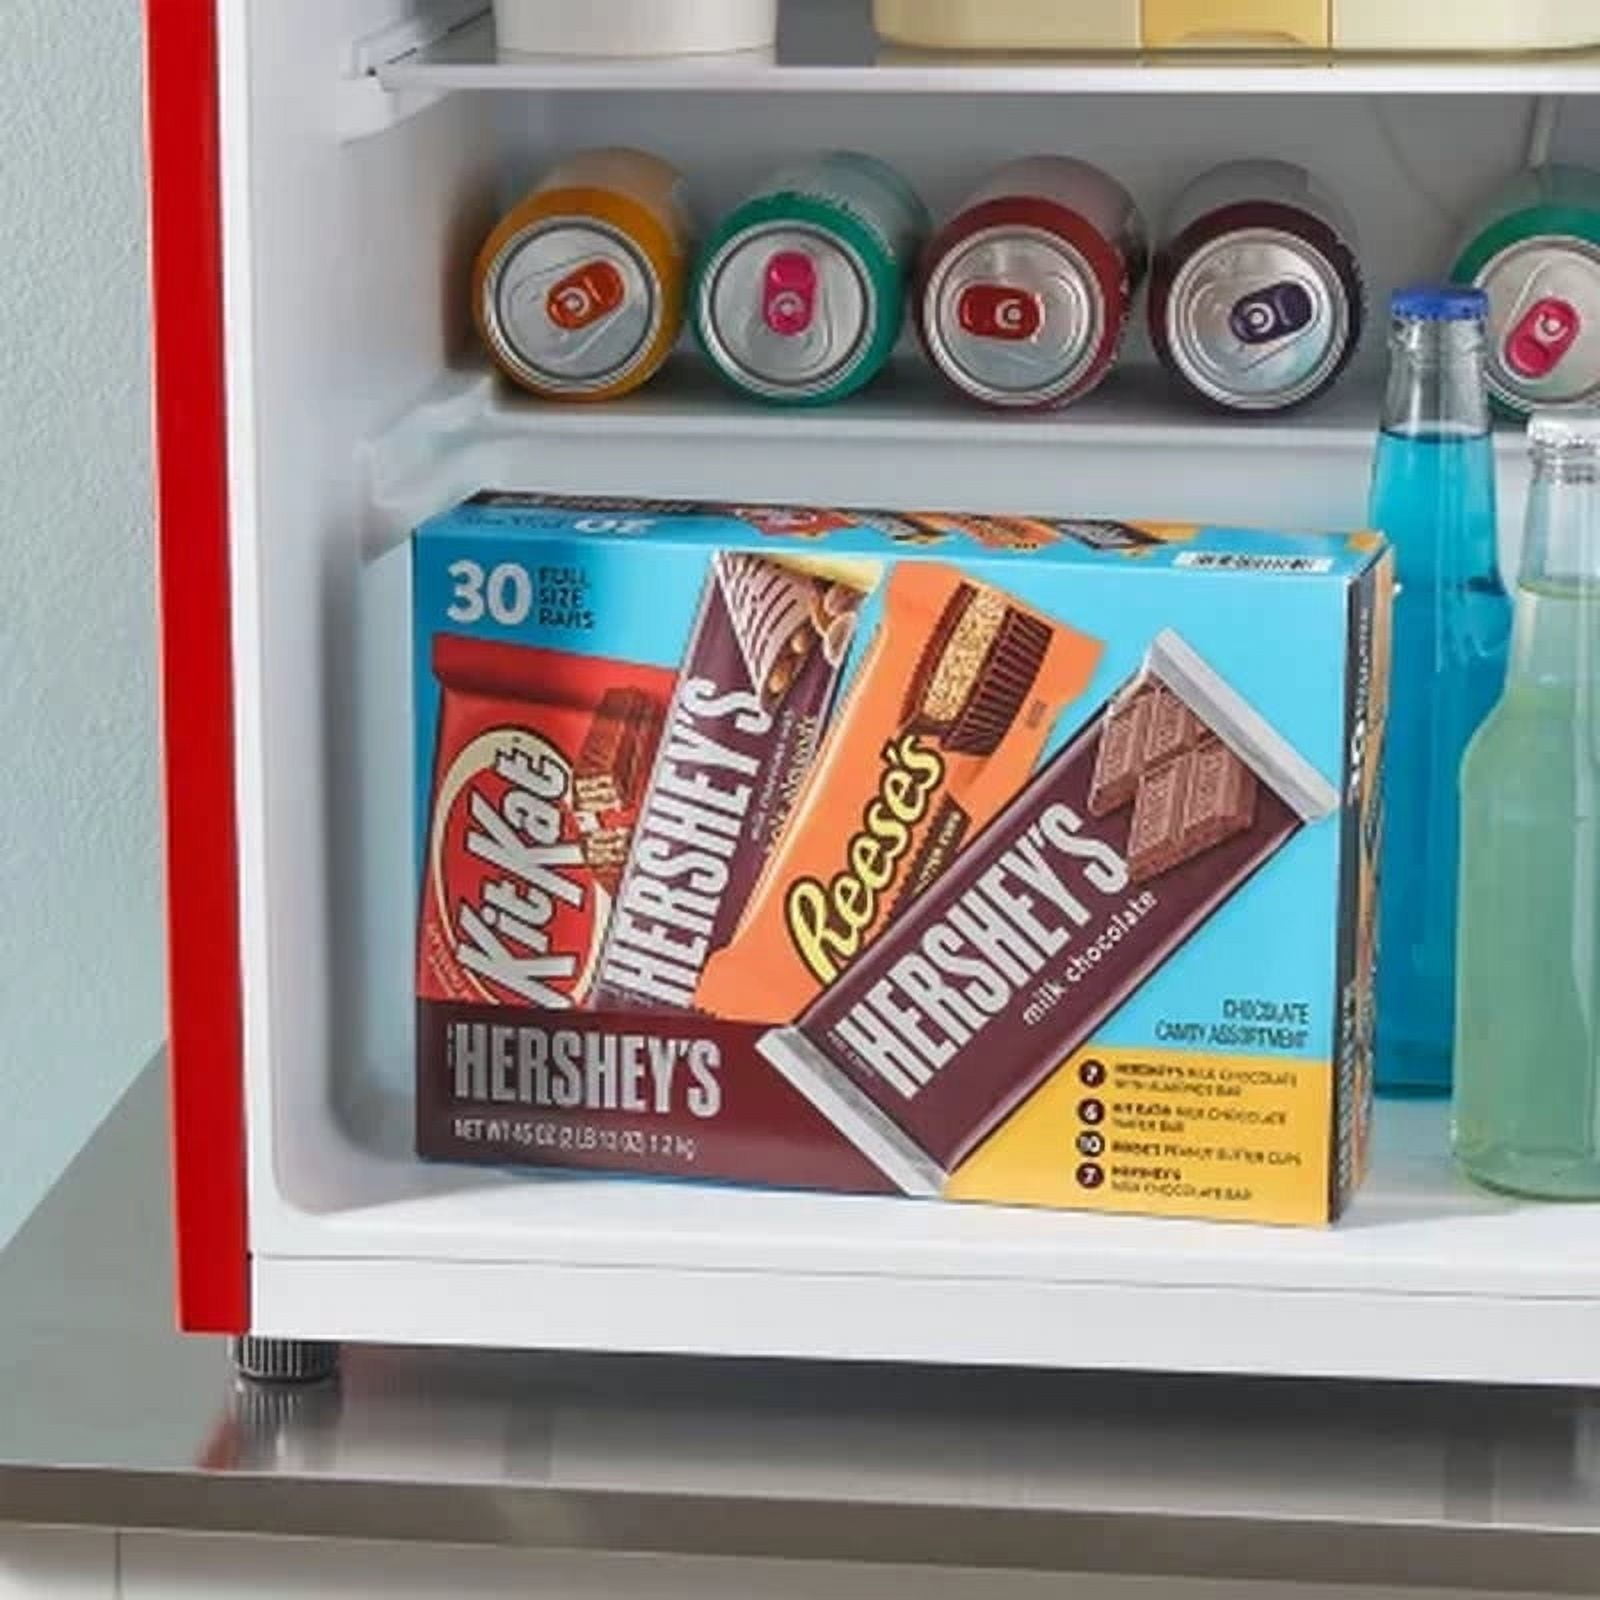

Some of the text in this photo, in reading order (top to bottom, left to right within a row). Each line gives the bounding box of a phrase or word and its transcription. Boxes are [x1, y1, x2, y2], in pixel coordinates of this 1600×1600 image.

[447, 560, 531, 625] 30
[539, 566, 591, 589] FULL
[539, 588, 584, 609] SIZE
[601, 677, 773, 1008] HERSHEY'S
[834, 803, 1130, 1100] HERSHEY'S
[1023, 889, 1158, 1025] milk chocolate
[453, 1023, 722, 1118] HERSHEY'S
[453, 1118, 484, 1138] NET
